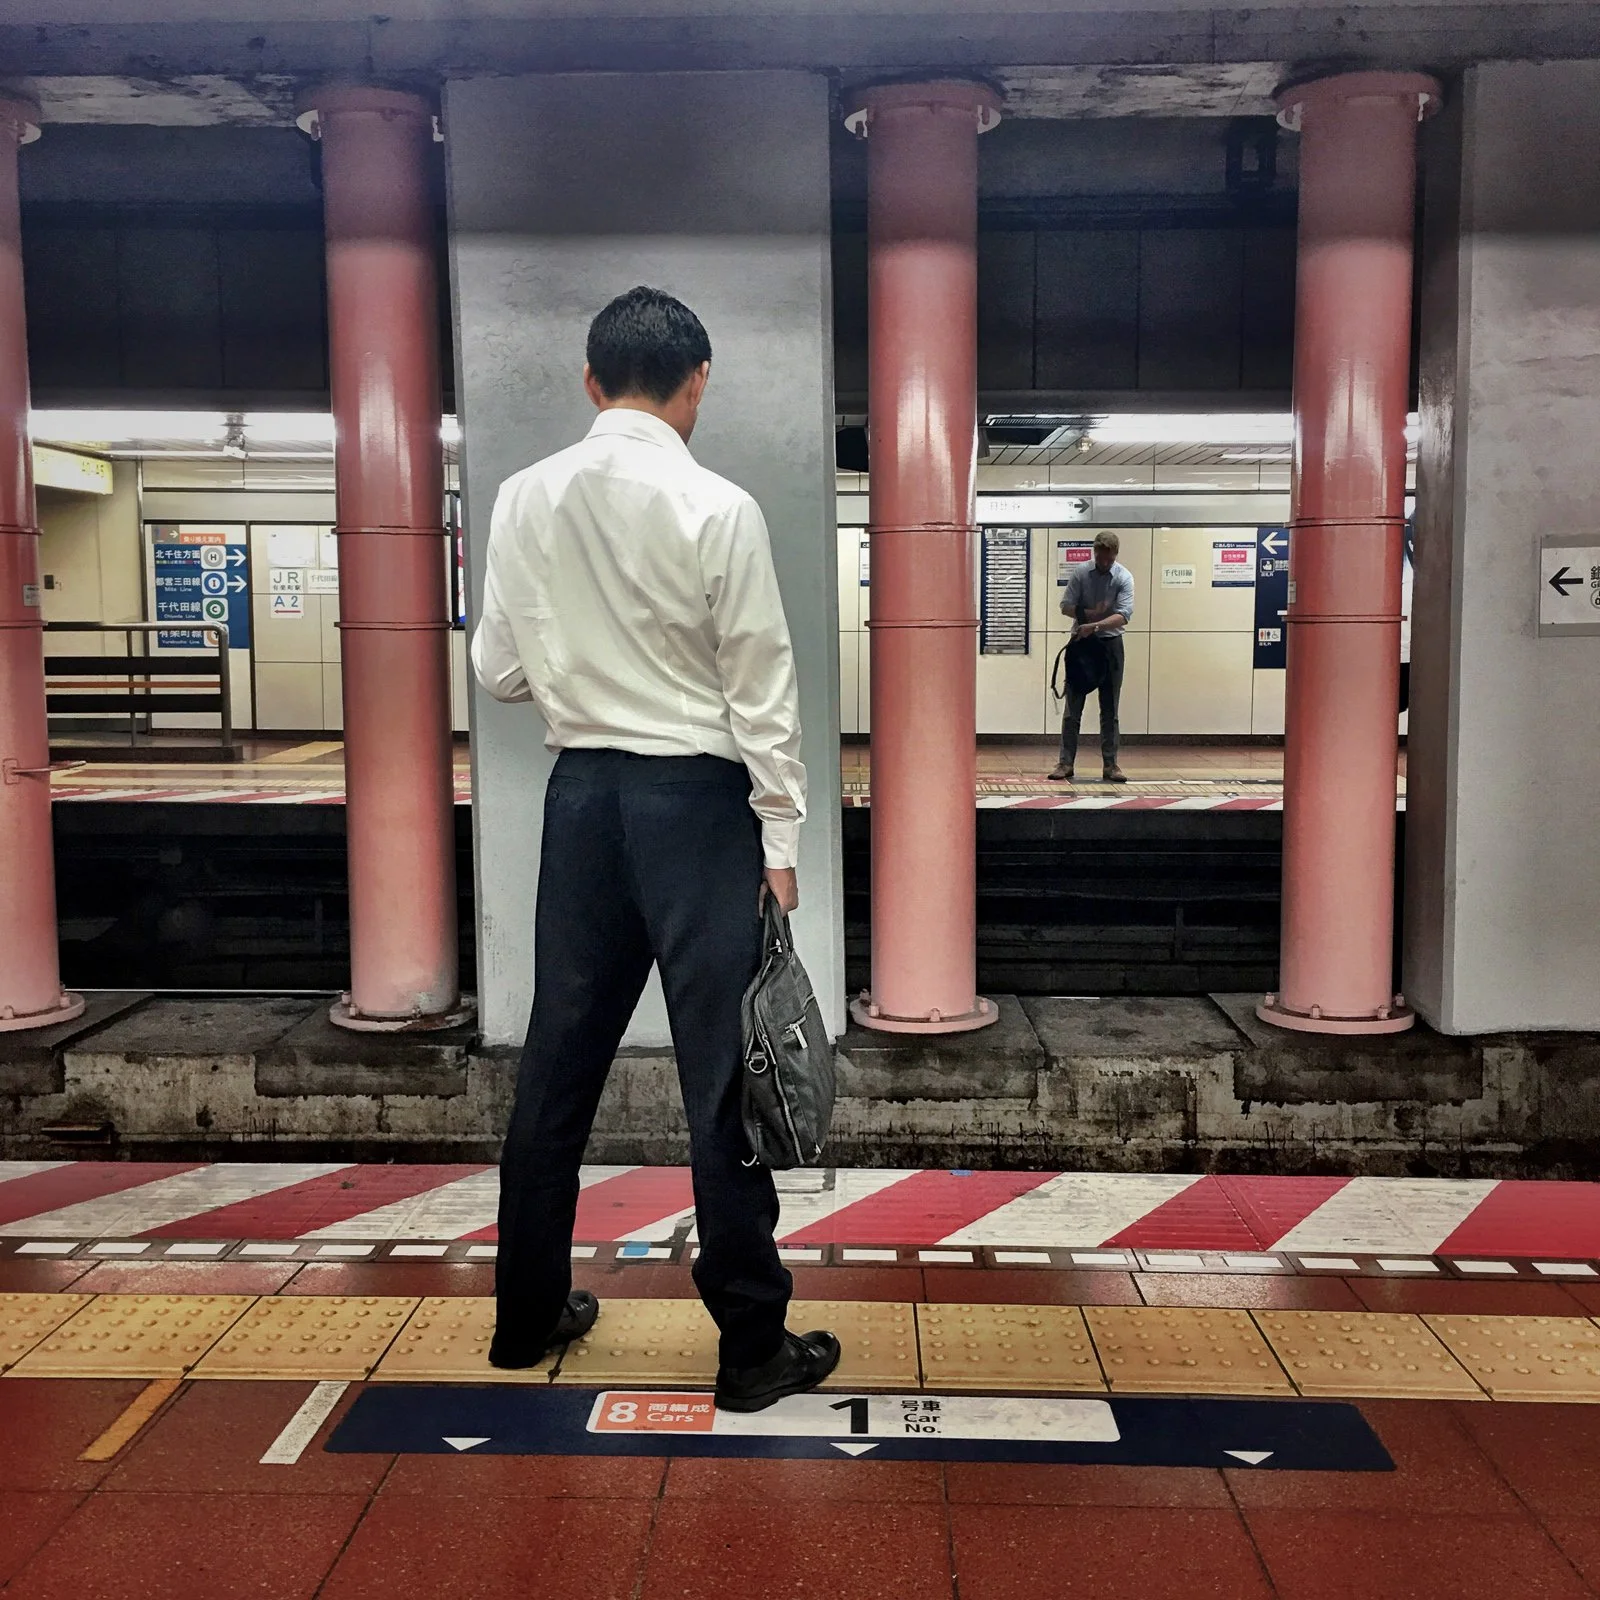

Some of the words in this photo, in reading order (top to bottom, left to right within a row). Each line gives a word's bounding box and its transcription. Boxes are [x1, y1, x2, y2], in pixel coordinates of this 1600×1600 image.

[155, 550, 201, 559] 北千住方面
[210, 553, 217, 561] H
[1164, 569, 1193, 577] 千代田線
[155, 577, 201, 586] 都営三田線
[158, 601, 202, 612] 千代田線
[211, 605, 217, 613] C
[648, 1403, 711, 1413] 両編成
[900, 1400, 942, 1412] 号車
[607, 1401, 639, 1423] 8
[828, 1398, 869, 1434] 1
[646, 1412, 695, 1423] Cars
[903, 1413, 941, 1423] Car
[905, 1424, 942, 1434] No.
